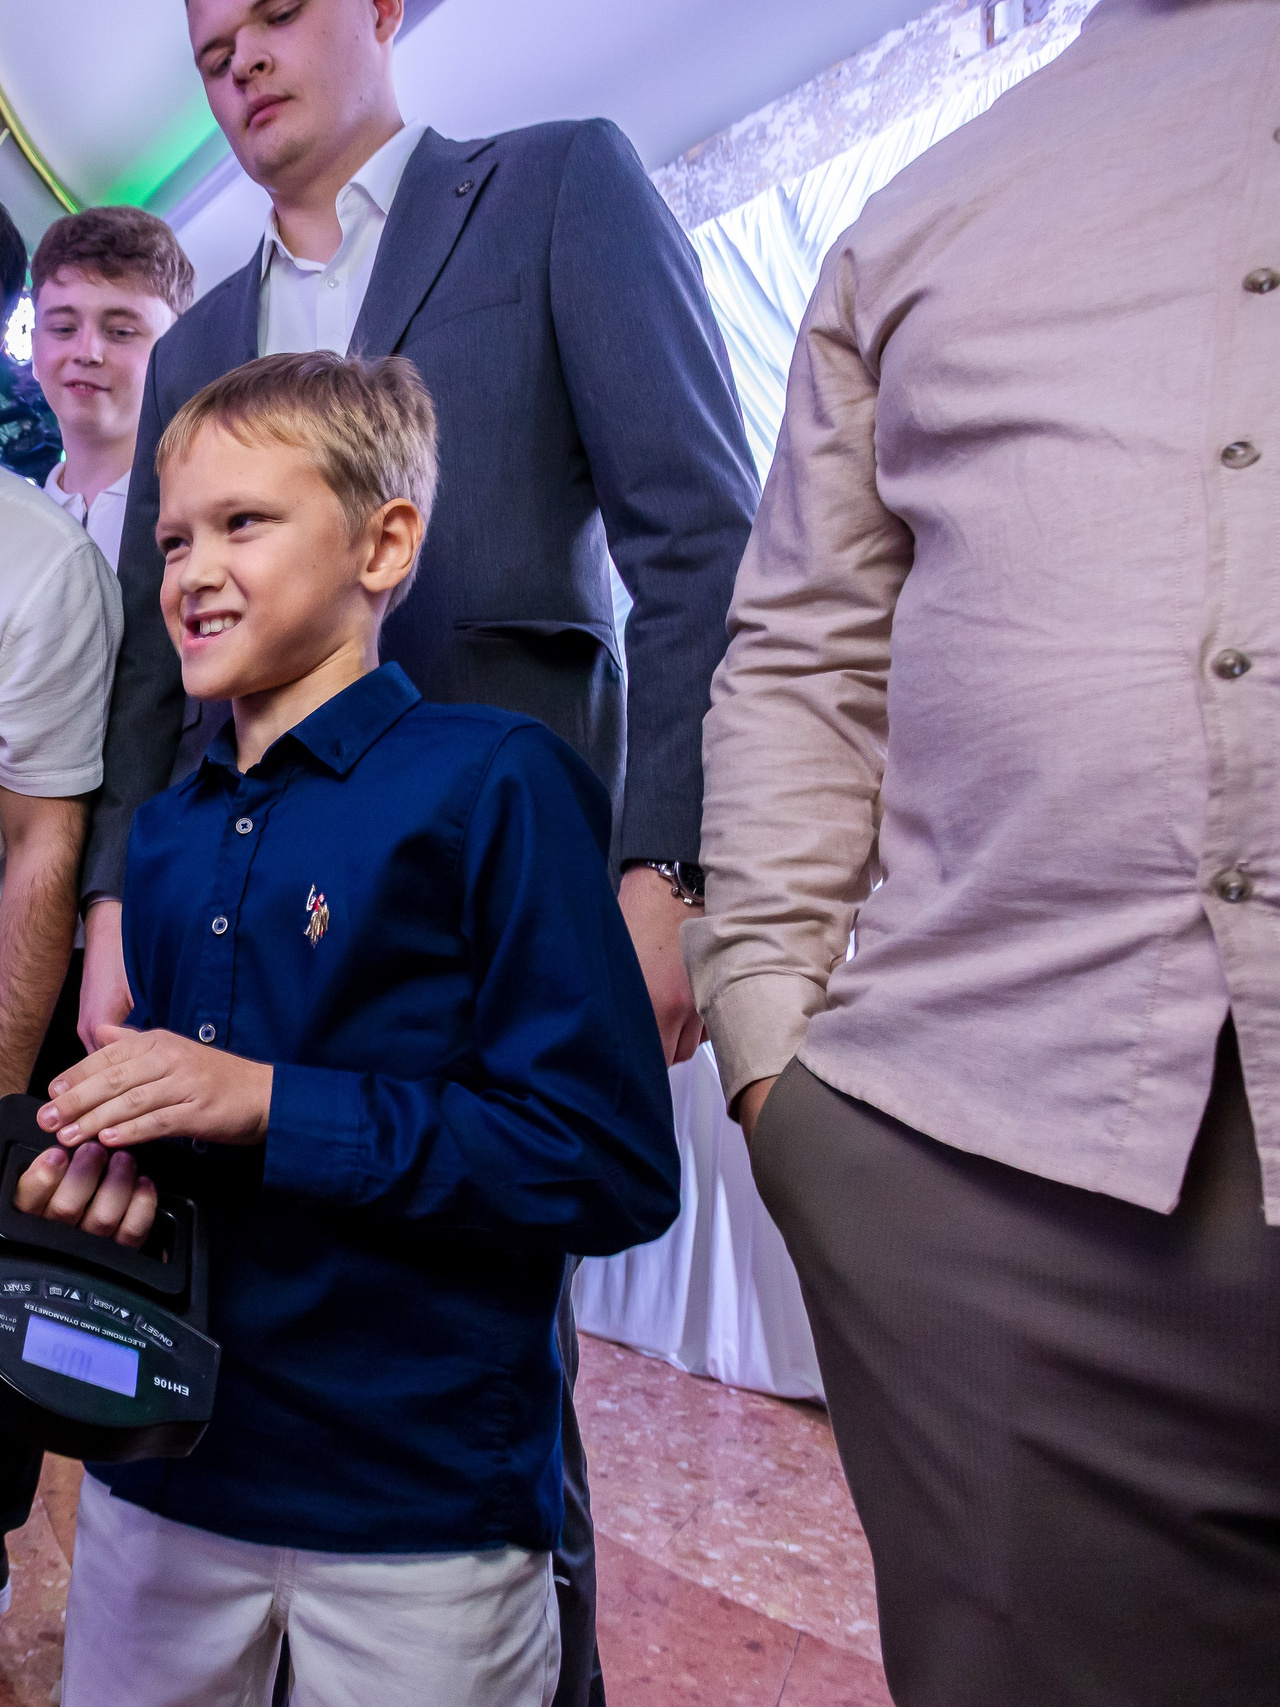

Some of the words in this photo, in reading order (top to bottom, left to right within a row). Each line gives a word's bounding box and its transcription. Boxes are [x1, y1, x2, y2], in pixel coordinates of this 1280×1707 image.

[3, 1284, 31, 1292] START
[24, 1302, 80, 1325] DYNAMOMETER
[0, 1322, 16, 1333] MAX
[80, 1321, 101, 1333] HAND
[141, 1322, 173, 1347] ON/SET
[101, 1329, 146, 1349] ELECTRONIC
[153, 1376, 190, 1397] EH106
